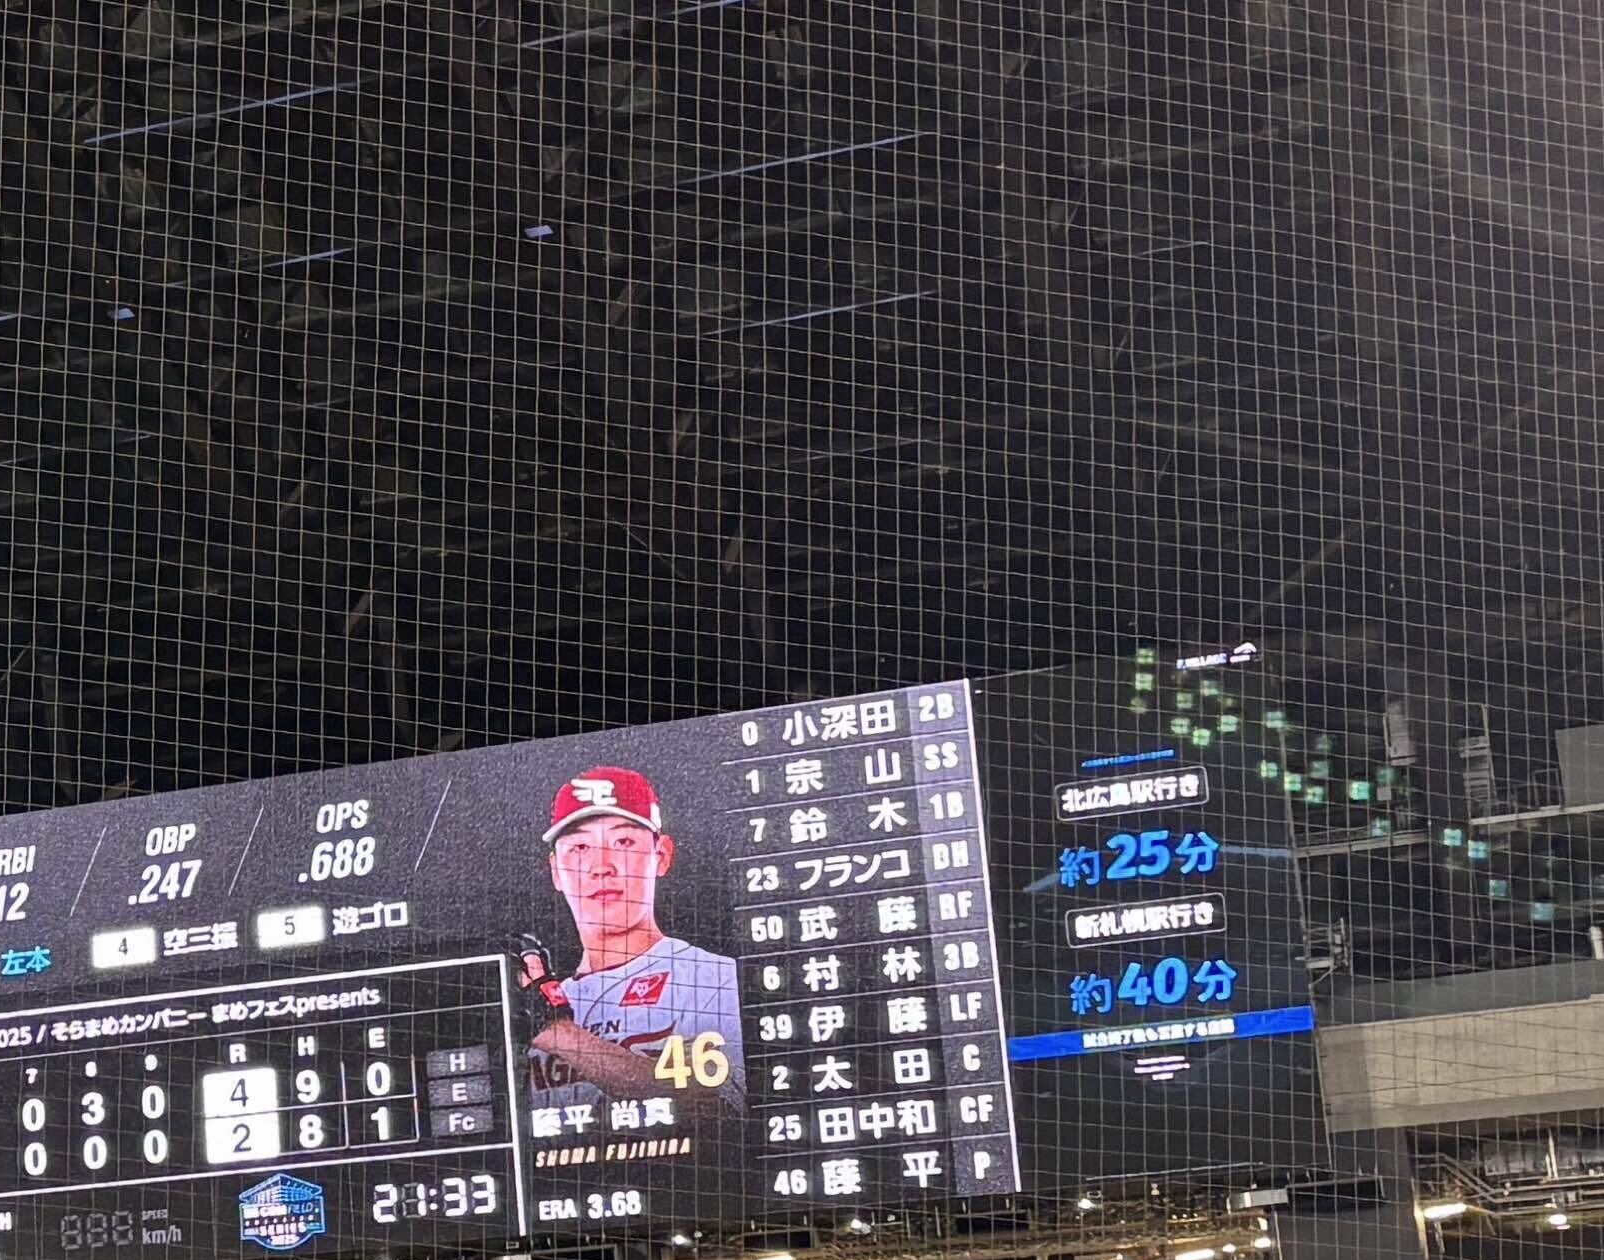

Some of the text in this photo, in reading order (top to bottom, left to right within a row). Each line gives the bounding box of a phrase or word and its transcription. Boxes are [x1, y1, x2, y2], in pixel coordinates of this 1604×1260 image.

[742, 693, 954, 746] 0 小深田 2B
[745, 741, 958, 795] 1 宗山 SS
[315, 800, 369, 834] OPS
[749, 791, 964, 844] 7 鈴木 1B
[1062, 774, 1199, 812] 北広島駅行き
[144, 824, 196, 857] OBP
[296, 836, 377, 885] .688
[1059, 829, 1219, 888] 約25分
[127, 860, 203, 907] .247
[746, 849, 911, 892] 23 フランコ
[0, 944, 51, 976] 左本
[162, 920, 238, 957] 空三振
[333, 900, 409, 936] 遊ゴロ
[751, 915, 783, 942] 50
[1075, 902, 1214, 939] 新札幌駅行き
[763, 941, 979, 992] 6 村林 3B
[1070, 957, 1237, 1016] 約40分
[759, 992, 982, 1041] 39 LF
[229, 1027, 385, 1063] R H E
[654, 1031, 730, 1089] 46
[772, 1044, 981, 1092] 2 太田 C
[22, 1098, 46, 1132] 0
[81, 1092, 105, 1126] 3
[141, 1086, 165, 1120] 0
[229, 1079, 248, 1107] 4
[295, 1070, 320, 1104] 9
[366, 1061, 391, 1096] 0
[768, 1094, 993, 1144] 25 田中和 CF
[143, 1130, 168, 1164] 0
[231, 1124, 252, 1153] 2
[298, 1115, 323, 1148] 8
[371, 1107, 389, 1141] 1
[535, 1146, 597, 1168] SHOMA
[774, 1151, 991, 1195] 46 P
[372, 1174, 497, 1224] 21:33
[538, 1190, 642, 1221] ERA 3.68
[142, 1224, 182, 1246] km/h
